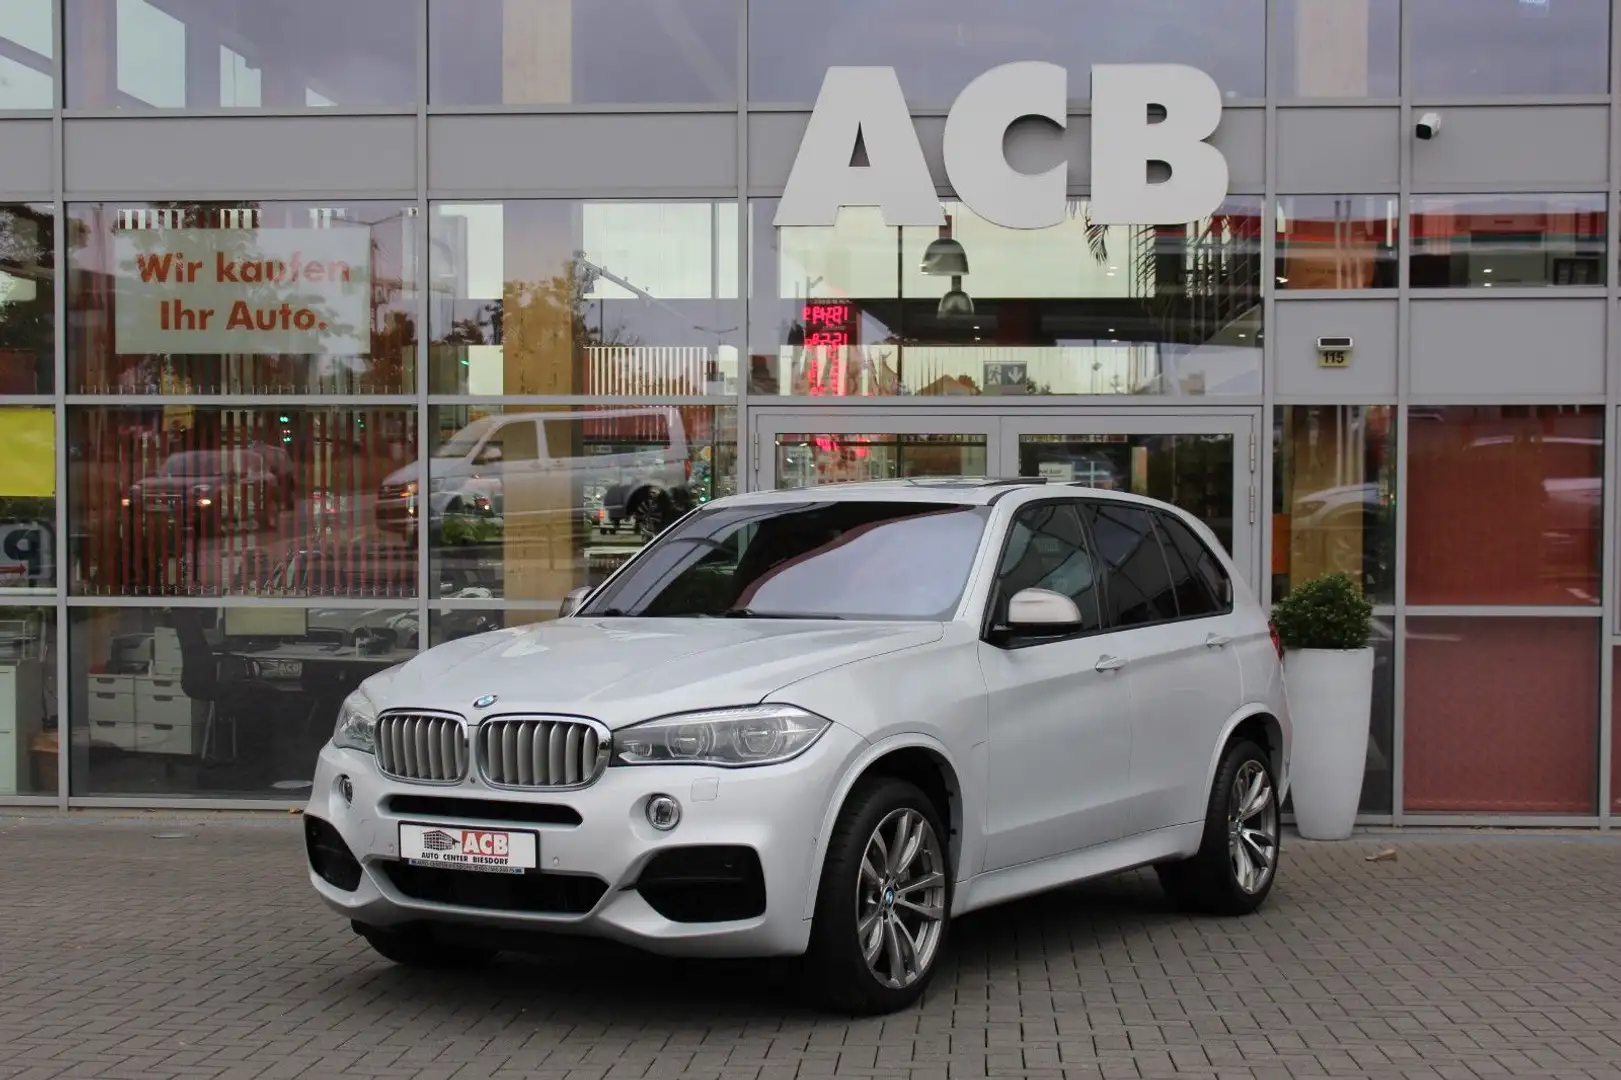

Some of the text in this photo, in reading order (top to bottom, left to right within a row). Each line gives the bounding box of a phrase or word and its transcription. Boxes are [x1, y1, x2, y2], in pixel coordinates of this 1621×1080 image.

[773, 60, 1229, 229] ACB
[136, 251, 350, 283] Wir kaufen
[160, 299, 328, 331] Ihr Auto.
[1322, 351, 1345, 364] 115
[464, 832, 509, 856] ACB
[421, 852, 509, 865] AUTO CENTER BIESDORF
